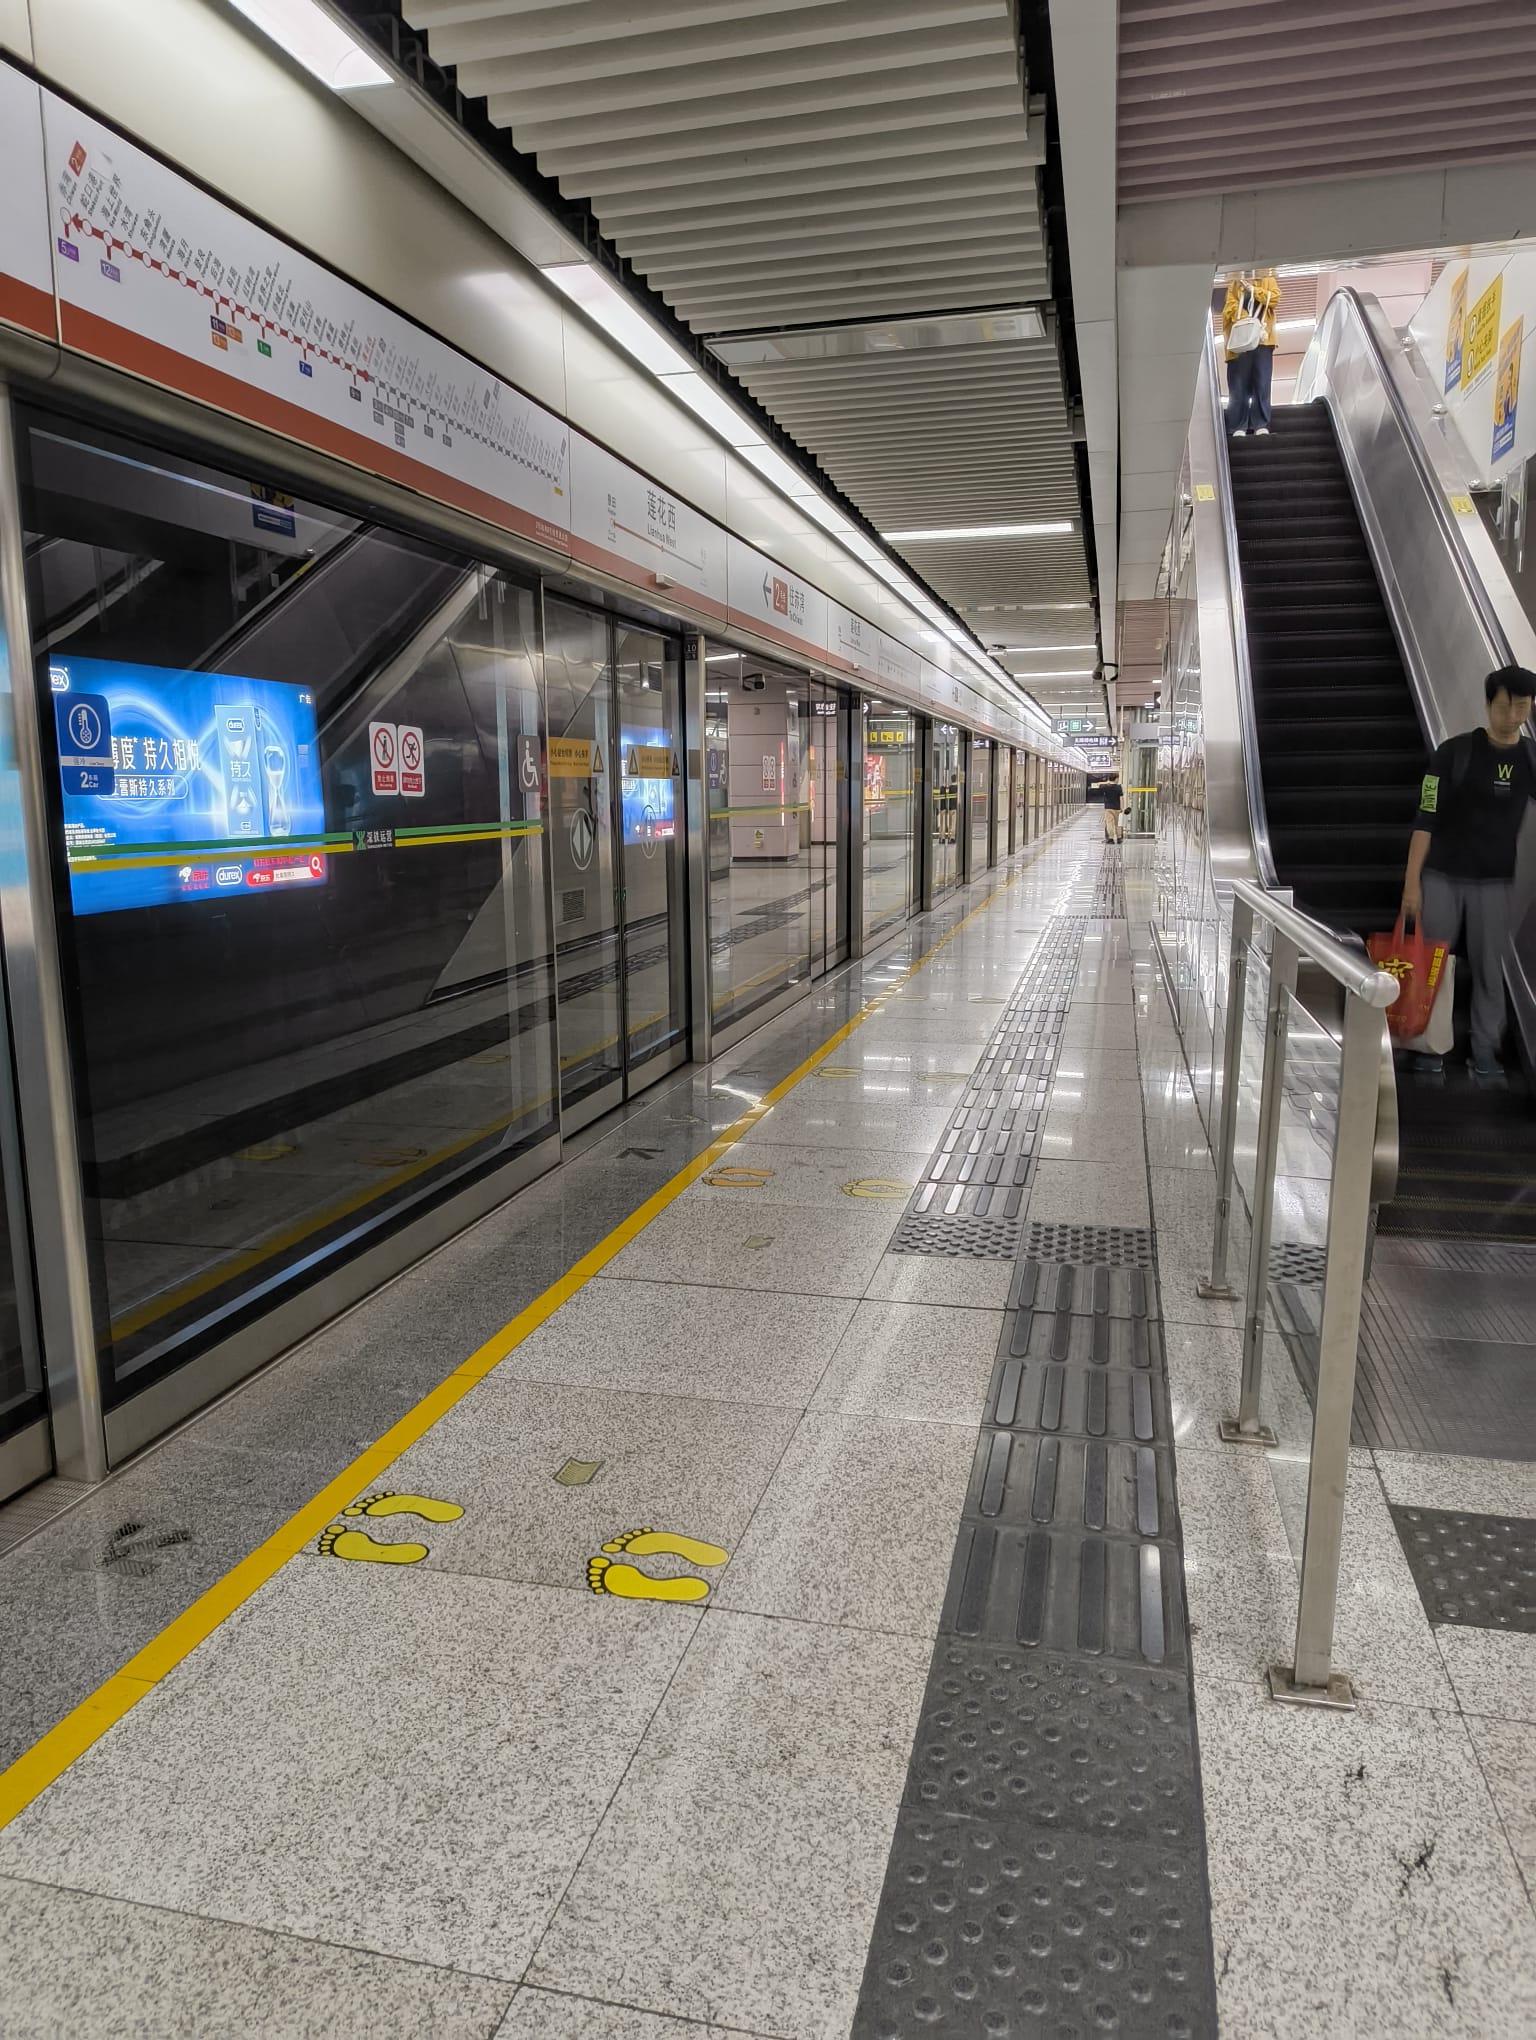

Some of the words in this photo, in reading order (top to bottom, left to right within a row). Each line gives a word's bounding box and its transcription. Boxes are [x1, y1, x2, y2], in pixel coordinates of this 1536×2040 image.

[647, 489, 676, 532] 莲花西
[647, 523, 666, 543] Lianhua
[665, 533, 676, 548] West
[143, 738, 201, 771] 持久相悦
[230, 760, 252, 778] 持久
[1497, 763, 1514, 779] W
[80, 771, 89, 788] 2
[366, 830, 392, 844] 深铁运营
[218, 867, 240, 882] durex
